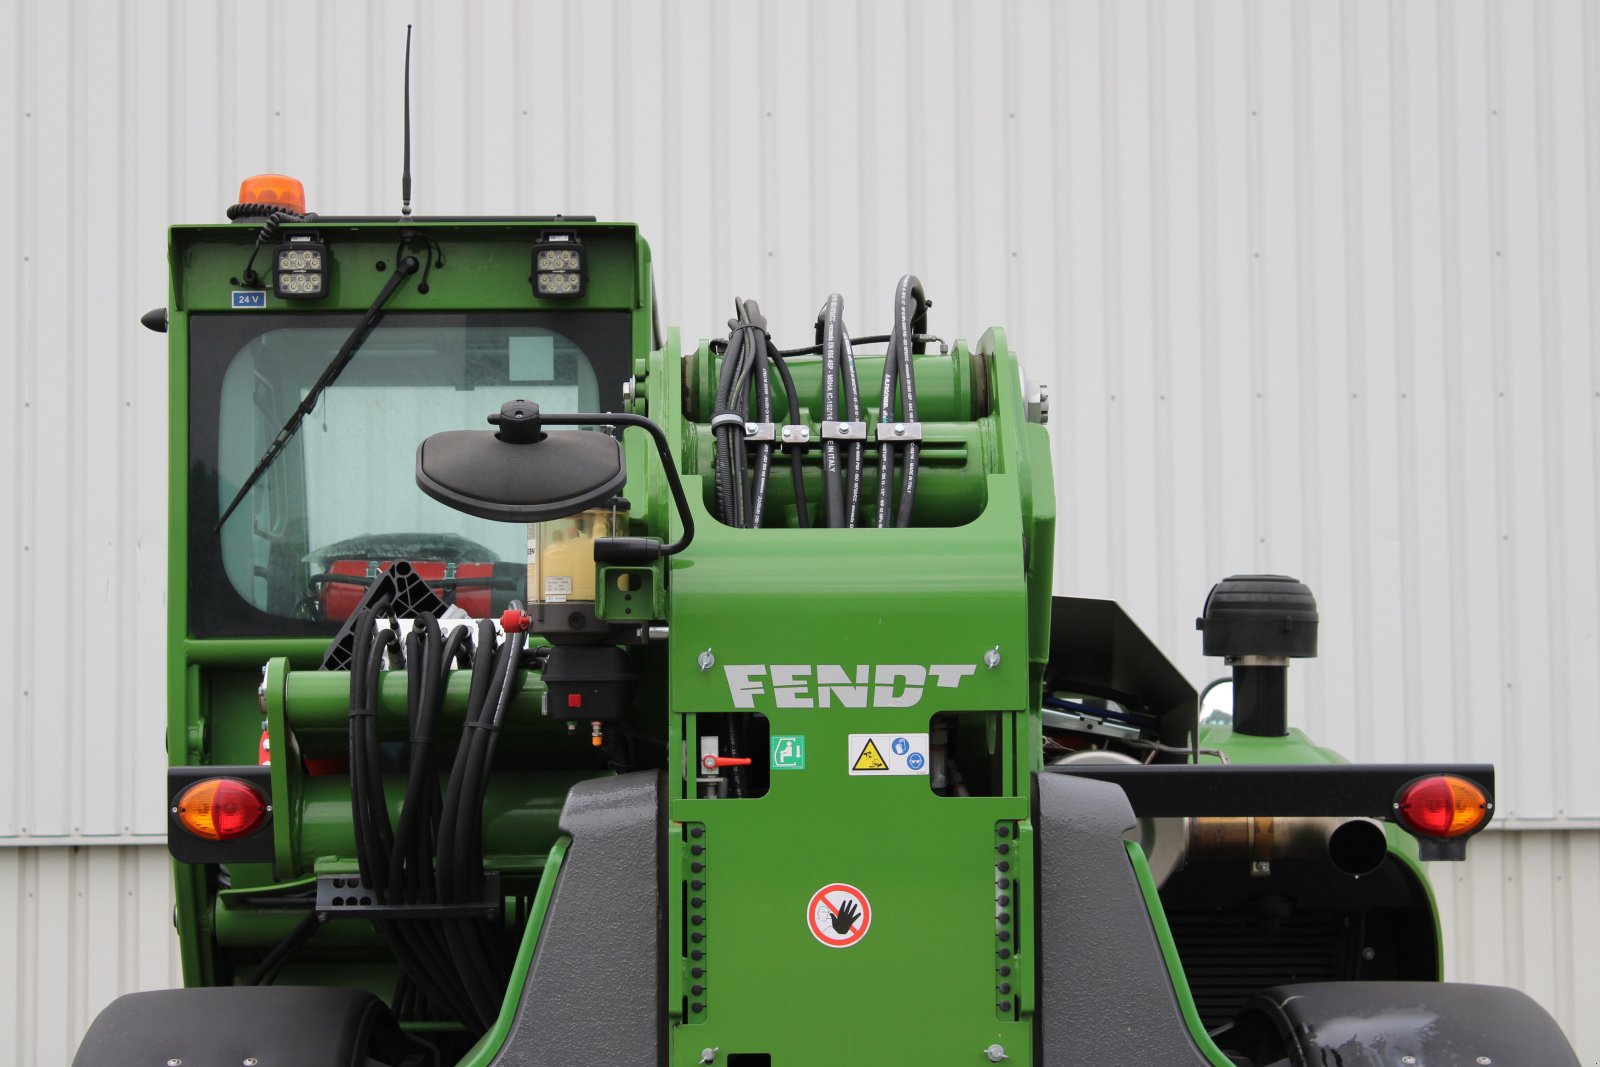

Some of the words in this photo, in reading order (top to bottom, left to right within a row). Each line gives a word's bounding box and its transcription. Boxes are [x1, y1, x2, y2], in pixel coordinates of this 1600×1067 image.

[239, 295, 250, 304] 24
[251, 295, 259, 304] V
[827, 445, 835, 453] IN
[827, 453, 836, 473] ITALY
[723, 664, 977, 708] FENDT
